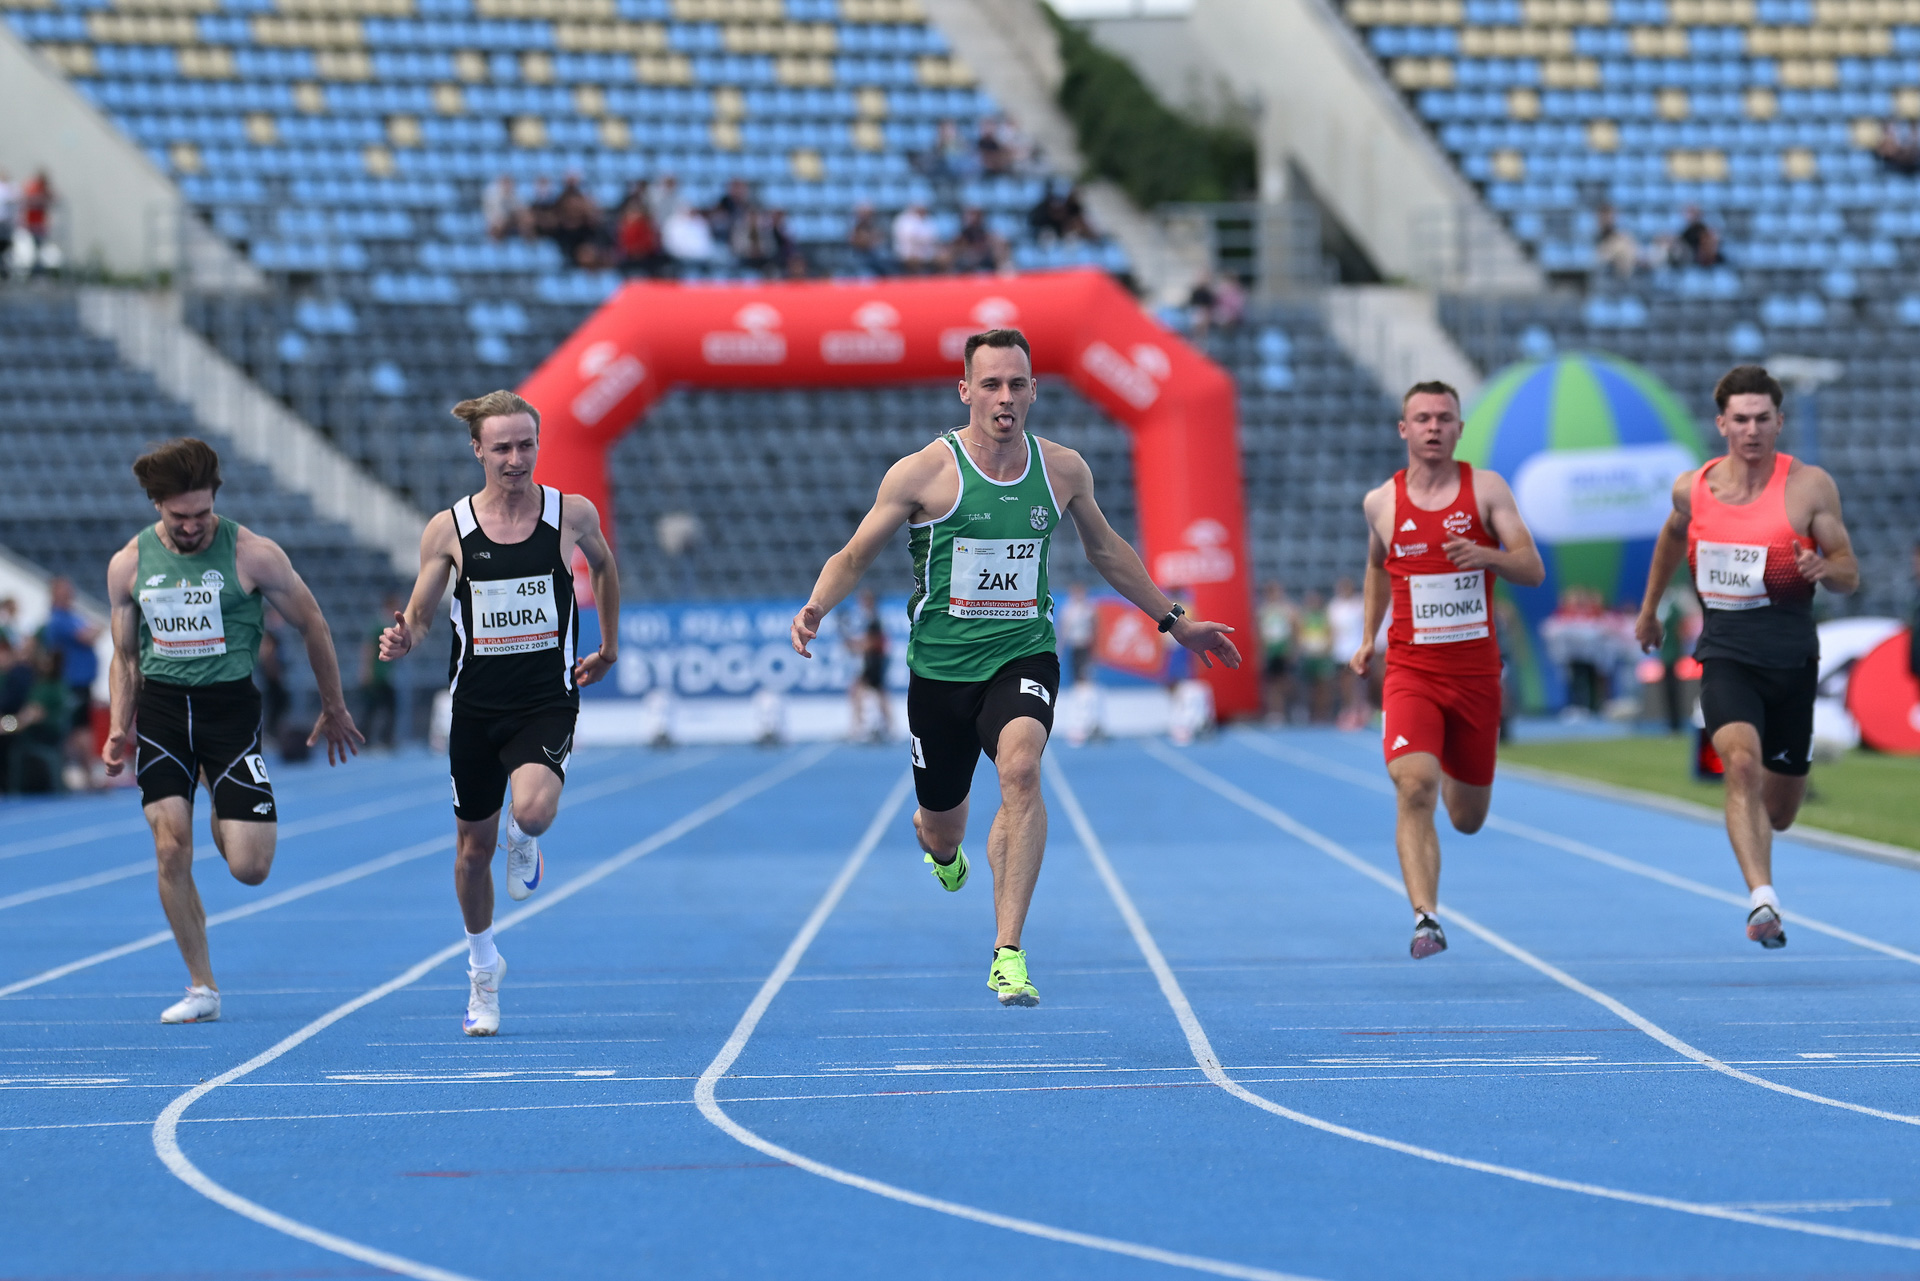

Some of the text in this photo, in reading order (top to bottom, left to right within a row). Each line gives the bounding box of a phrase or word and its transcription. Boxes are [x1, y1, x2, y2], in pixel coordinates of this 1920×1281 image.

[1006, 543, 1035, 560] 122
[1734, 548, 1760, 563] 329
[977, 568, 1018, 591] ŻAK
[1454, 575, 1479, 591] 127
[1710, 569, 1751, 588] FUJAK
[516, 580, 546, 597] 458
[183, 591, 212, 605] 220
[982, 600, 1019, 608] Mistrzostwa
[960, 609, 1010, 617] BYDGOSZCZ
[1415, 599, 1484, 619] LEPIONKA
[153, 616, 212, 632] DURKA
[482, 608, 548, 628] LIBURA
[484, 641, 549, 653] BYDGOSZCZ 2025
[502, 635, 538, 643] Mistrzostwa
[1028, 684, 1046, 697] 4
[254, 757, 267, 779] 6
